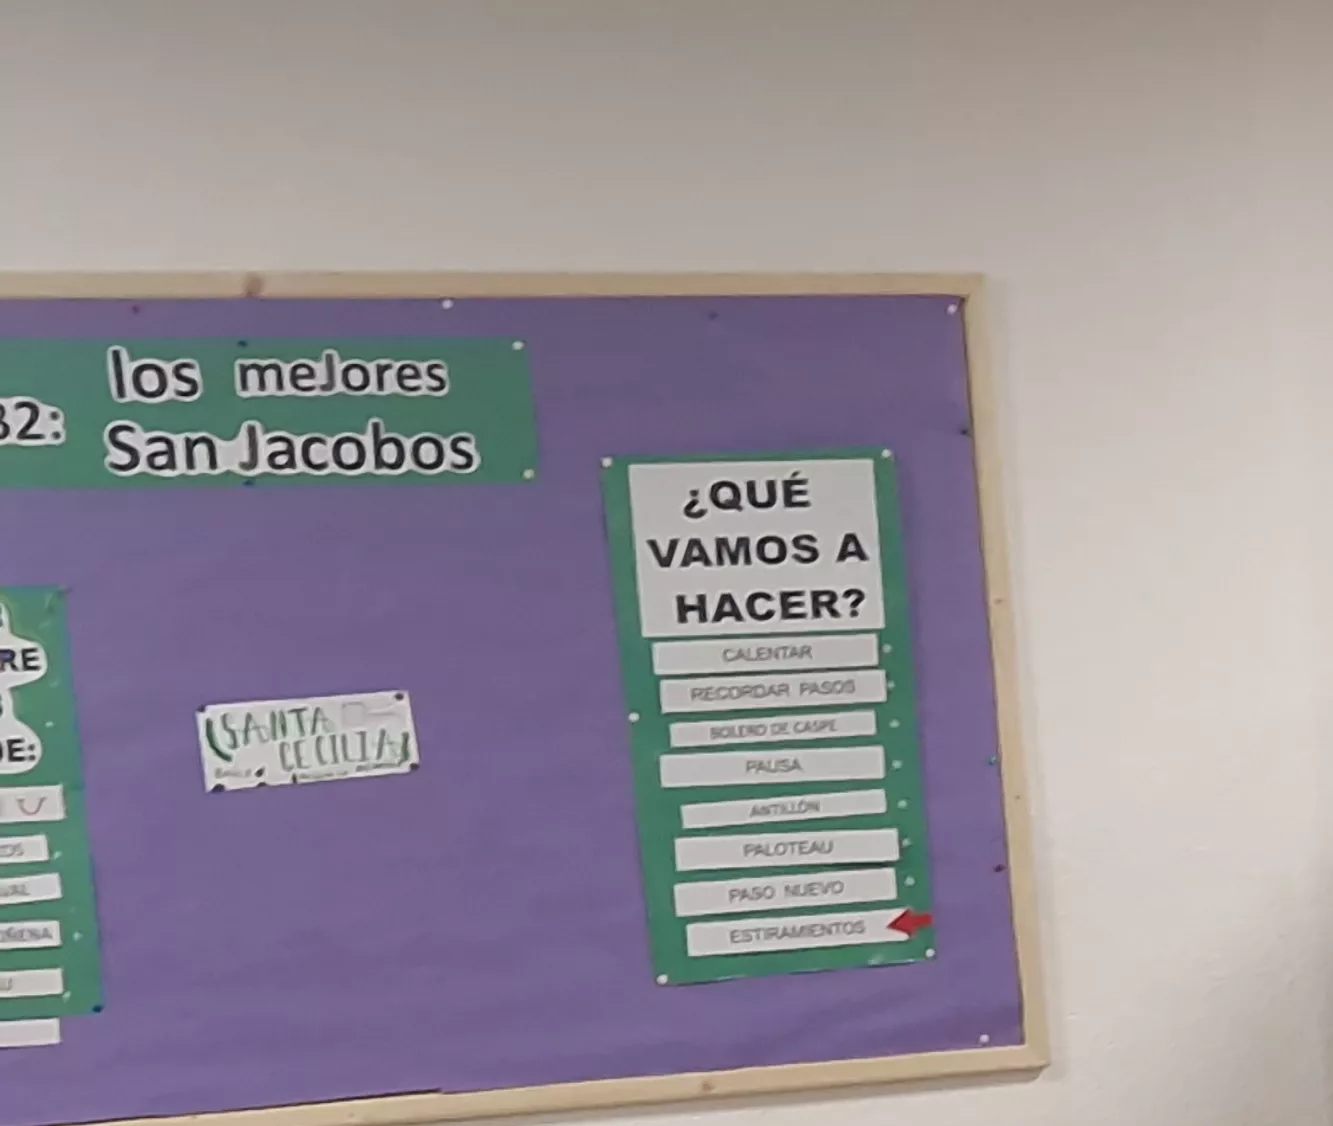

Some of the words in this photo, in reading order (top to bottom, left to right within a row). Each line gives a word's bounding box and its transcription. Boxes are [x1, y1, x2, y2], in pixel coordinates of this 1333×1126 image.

[111, 349, 199, 399] los
[107, 425, 217, 471] San
[239, 420, 475, 472] Jacobos
[683, 470, 811, 519] ¿QUÉ
[646, 534, 820, 568] VAMOS
[836, 533, 870, 562] A
[675, 588, 865, 623] HACER?
[722, 646, 813, 663] CALENTAR
[690, 682, 790, 701] RECORDAR
[800, 679, 856, 695] PASOS
[709, 723, 768, 740] BOLERO
[770, 722, 789, 735] DE
[793, 719, 838, 733] CASPE
[0, 739, 36, 763] E:
[745, 758, 803, 774] PAUSA
[743, 840, 834, 857] PALOTEAU
[728, 885, 776, 902] PASO
[784, 881, 845, 898] NUEVO
[729, 920, 867, 944] ESTIRAMIENTOS
